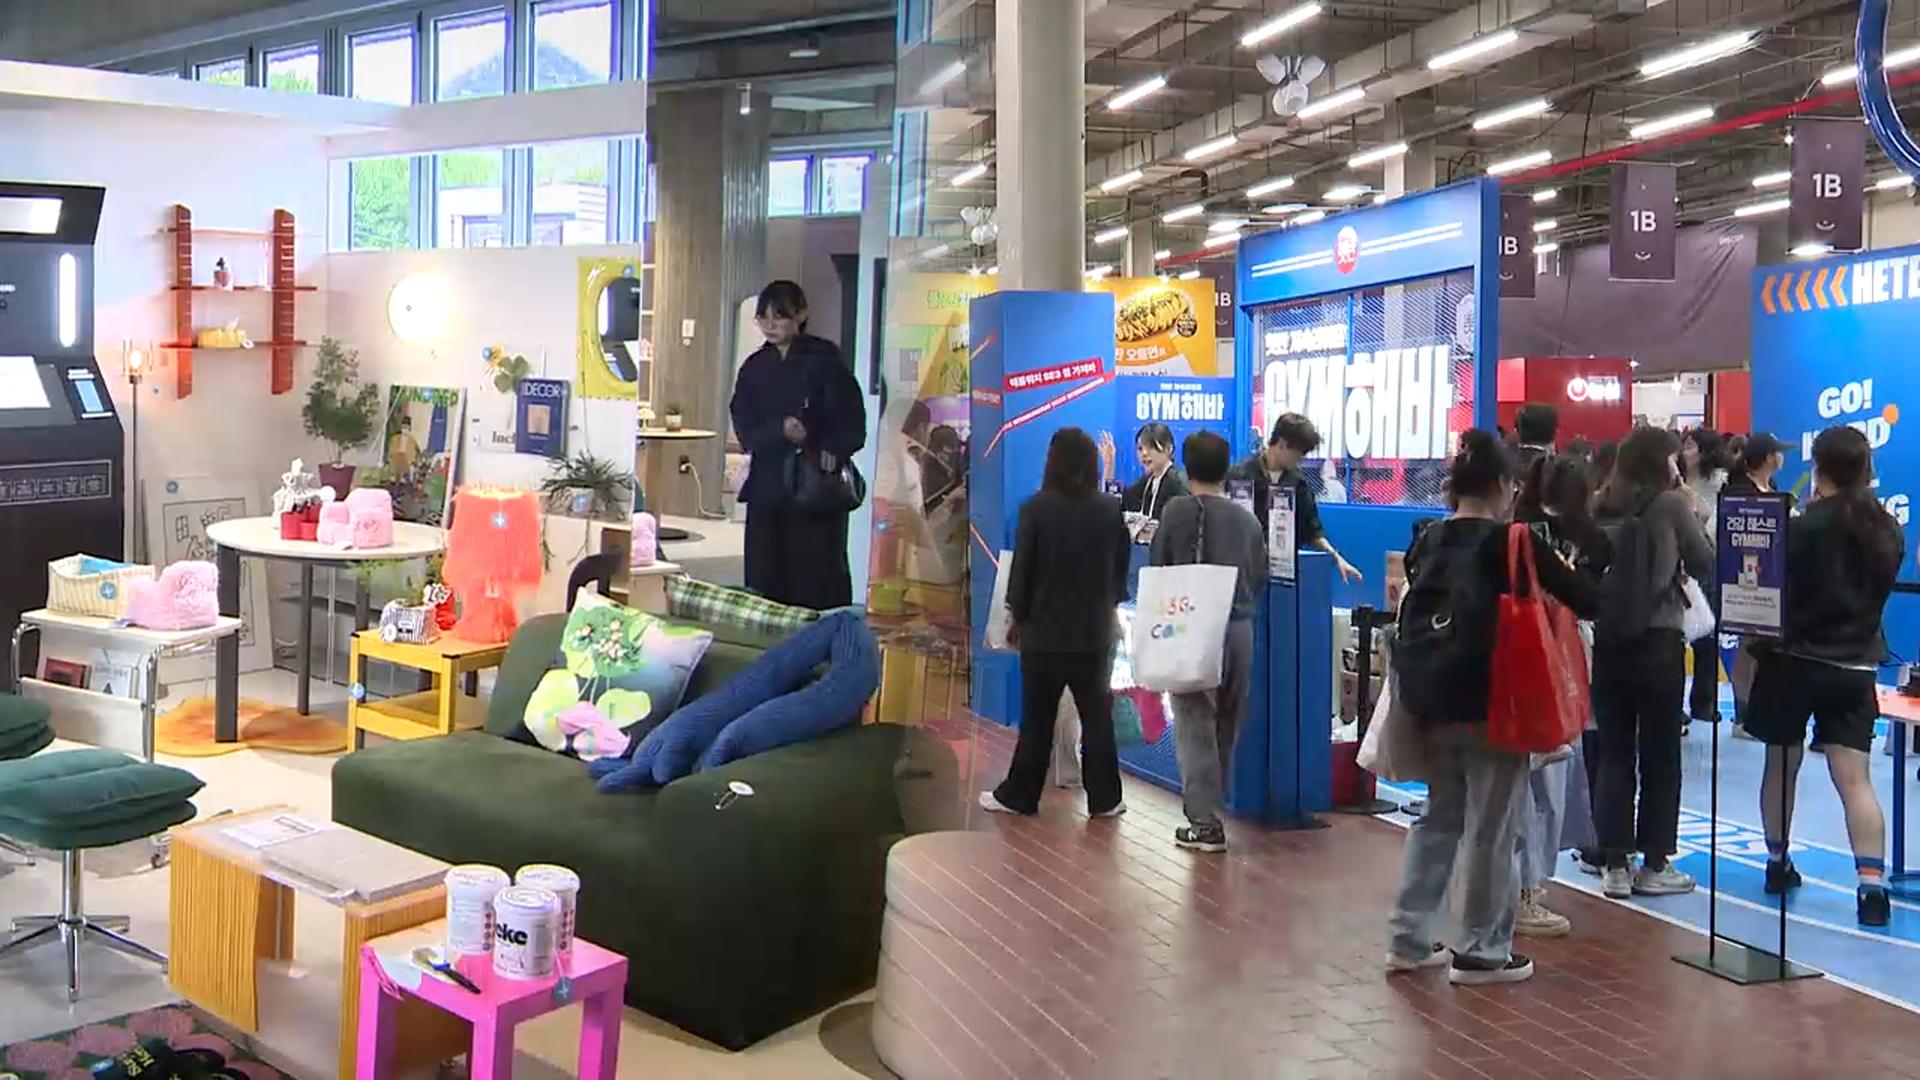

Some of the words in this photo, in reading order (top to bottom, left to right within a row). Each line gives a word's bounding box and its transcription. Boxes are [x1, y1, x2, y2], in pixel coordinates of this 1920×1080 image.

[1812, 173, 1842, 198] 1B
[1629, 210, 1657, 232] 1B
[1817, 378, 1873, 419] GO!
